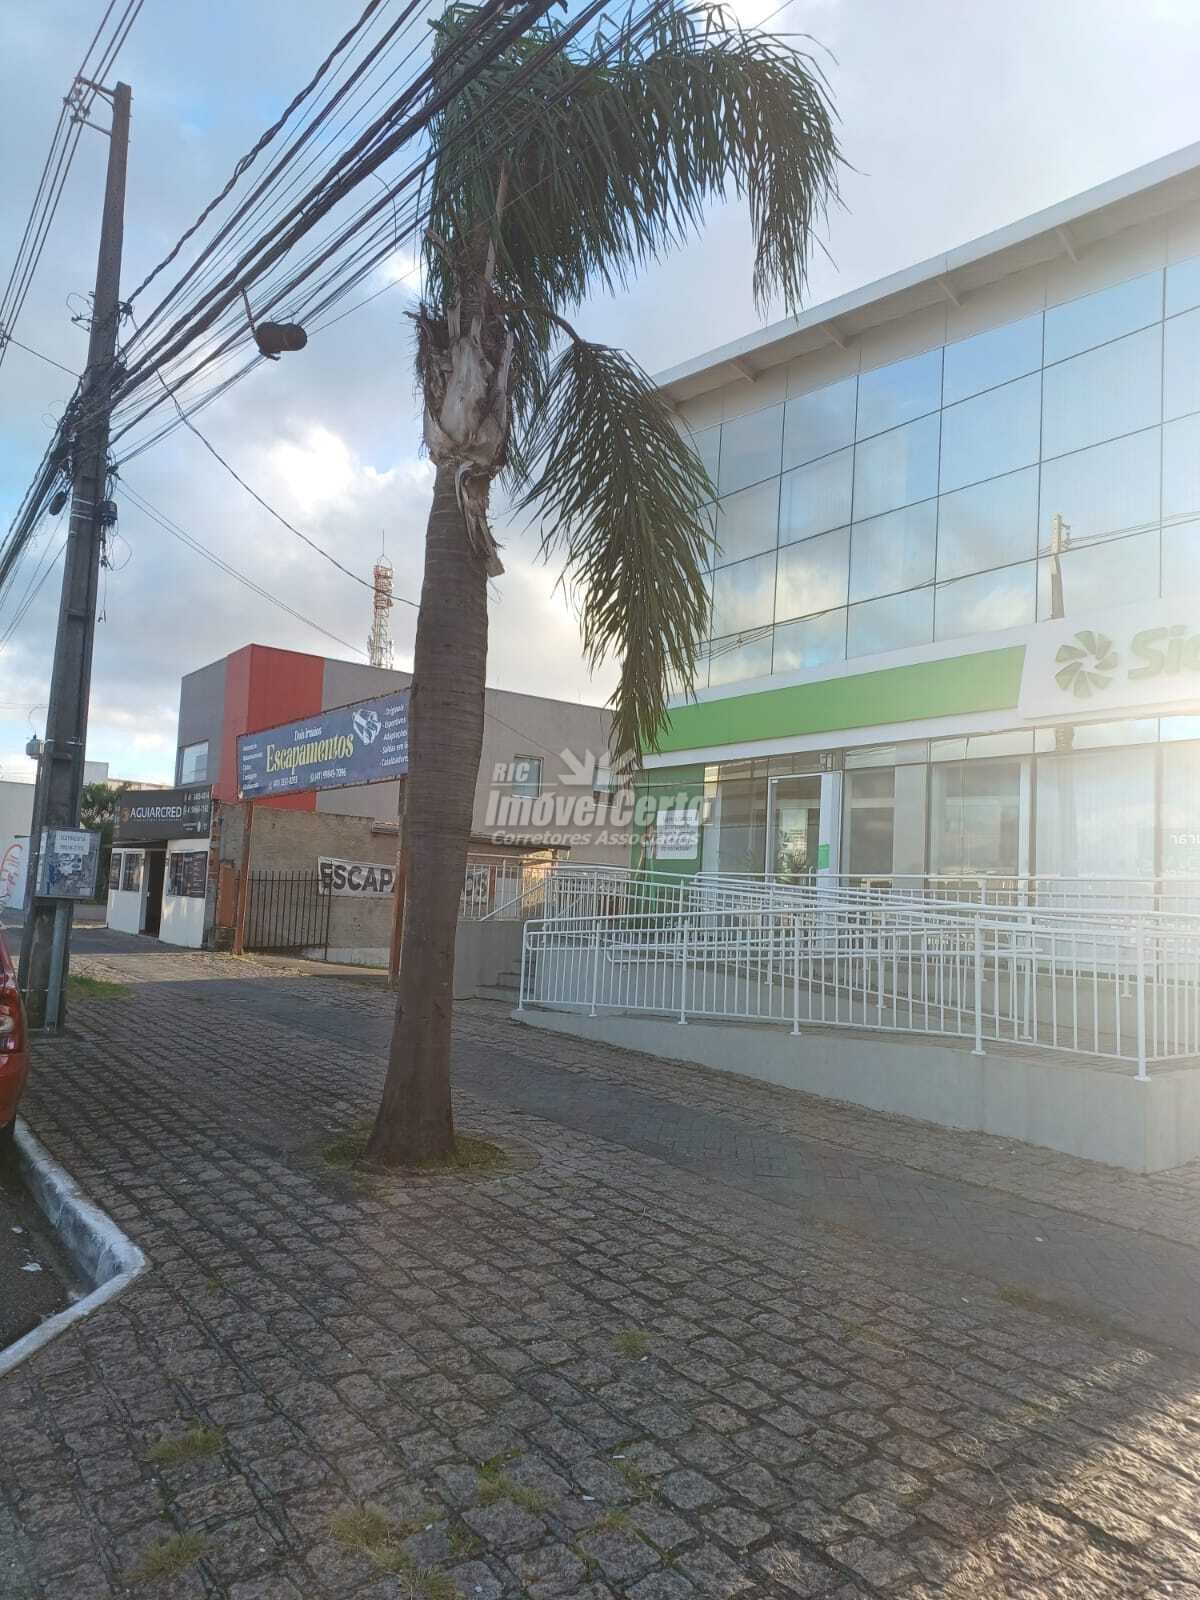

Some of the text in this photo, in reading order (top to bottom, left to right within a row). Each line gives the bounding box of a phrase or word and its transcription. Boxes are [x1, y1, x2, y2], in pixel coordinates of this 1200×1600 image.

[265, 733, 354, 776] Escapamentos
[129, 805, 182, 818] AGUIARCRED
[319, 861, 396, 893] ESCAP
